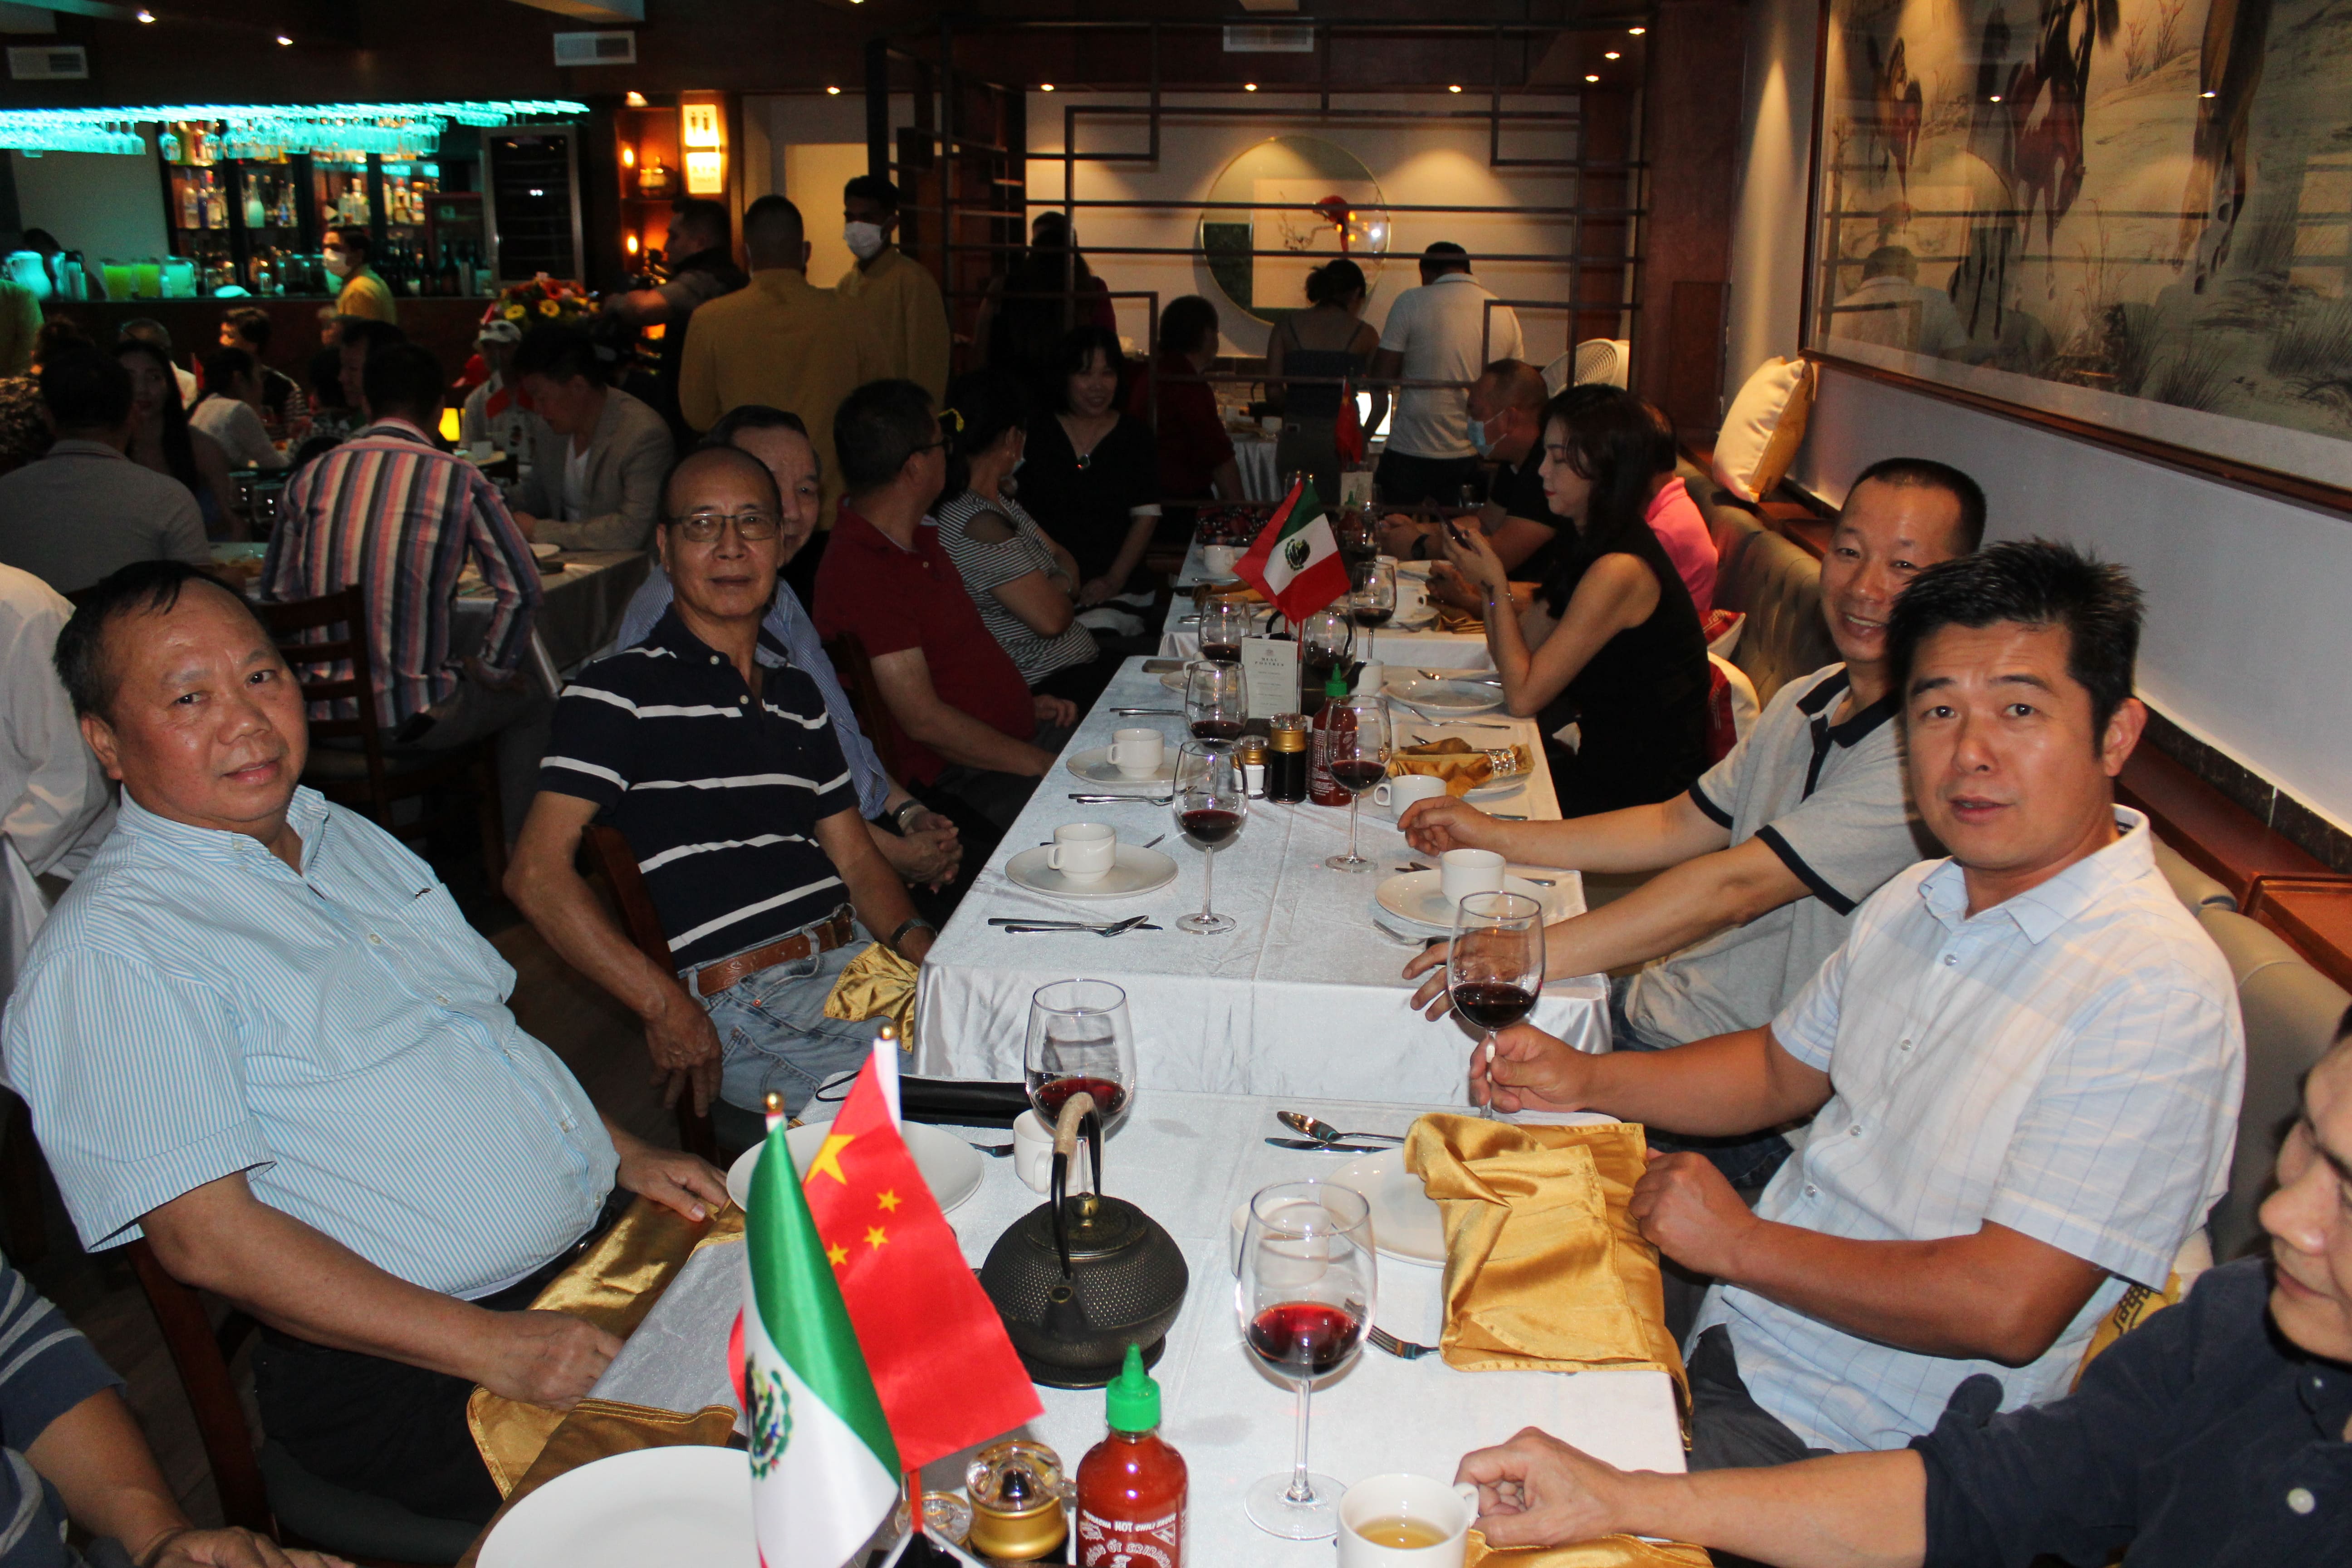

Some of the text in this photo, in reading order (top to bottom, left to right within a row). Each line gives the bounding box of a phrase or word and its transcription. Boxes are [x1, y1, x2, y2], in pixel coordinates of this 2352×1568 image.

[1114, 1520, 1133, 1533] HOT
[1135, 1522, 1156, 1532] CHILI
[1156, 1513, 1177, 1528] SAUCE
